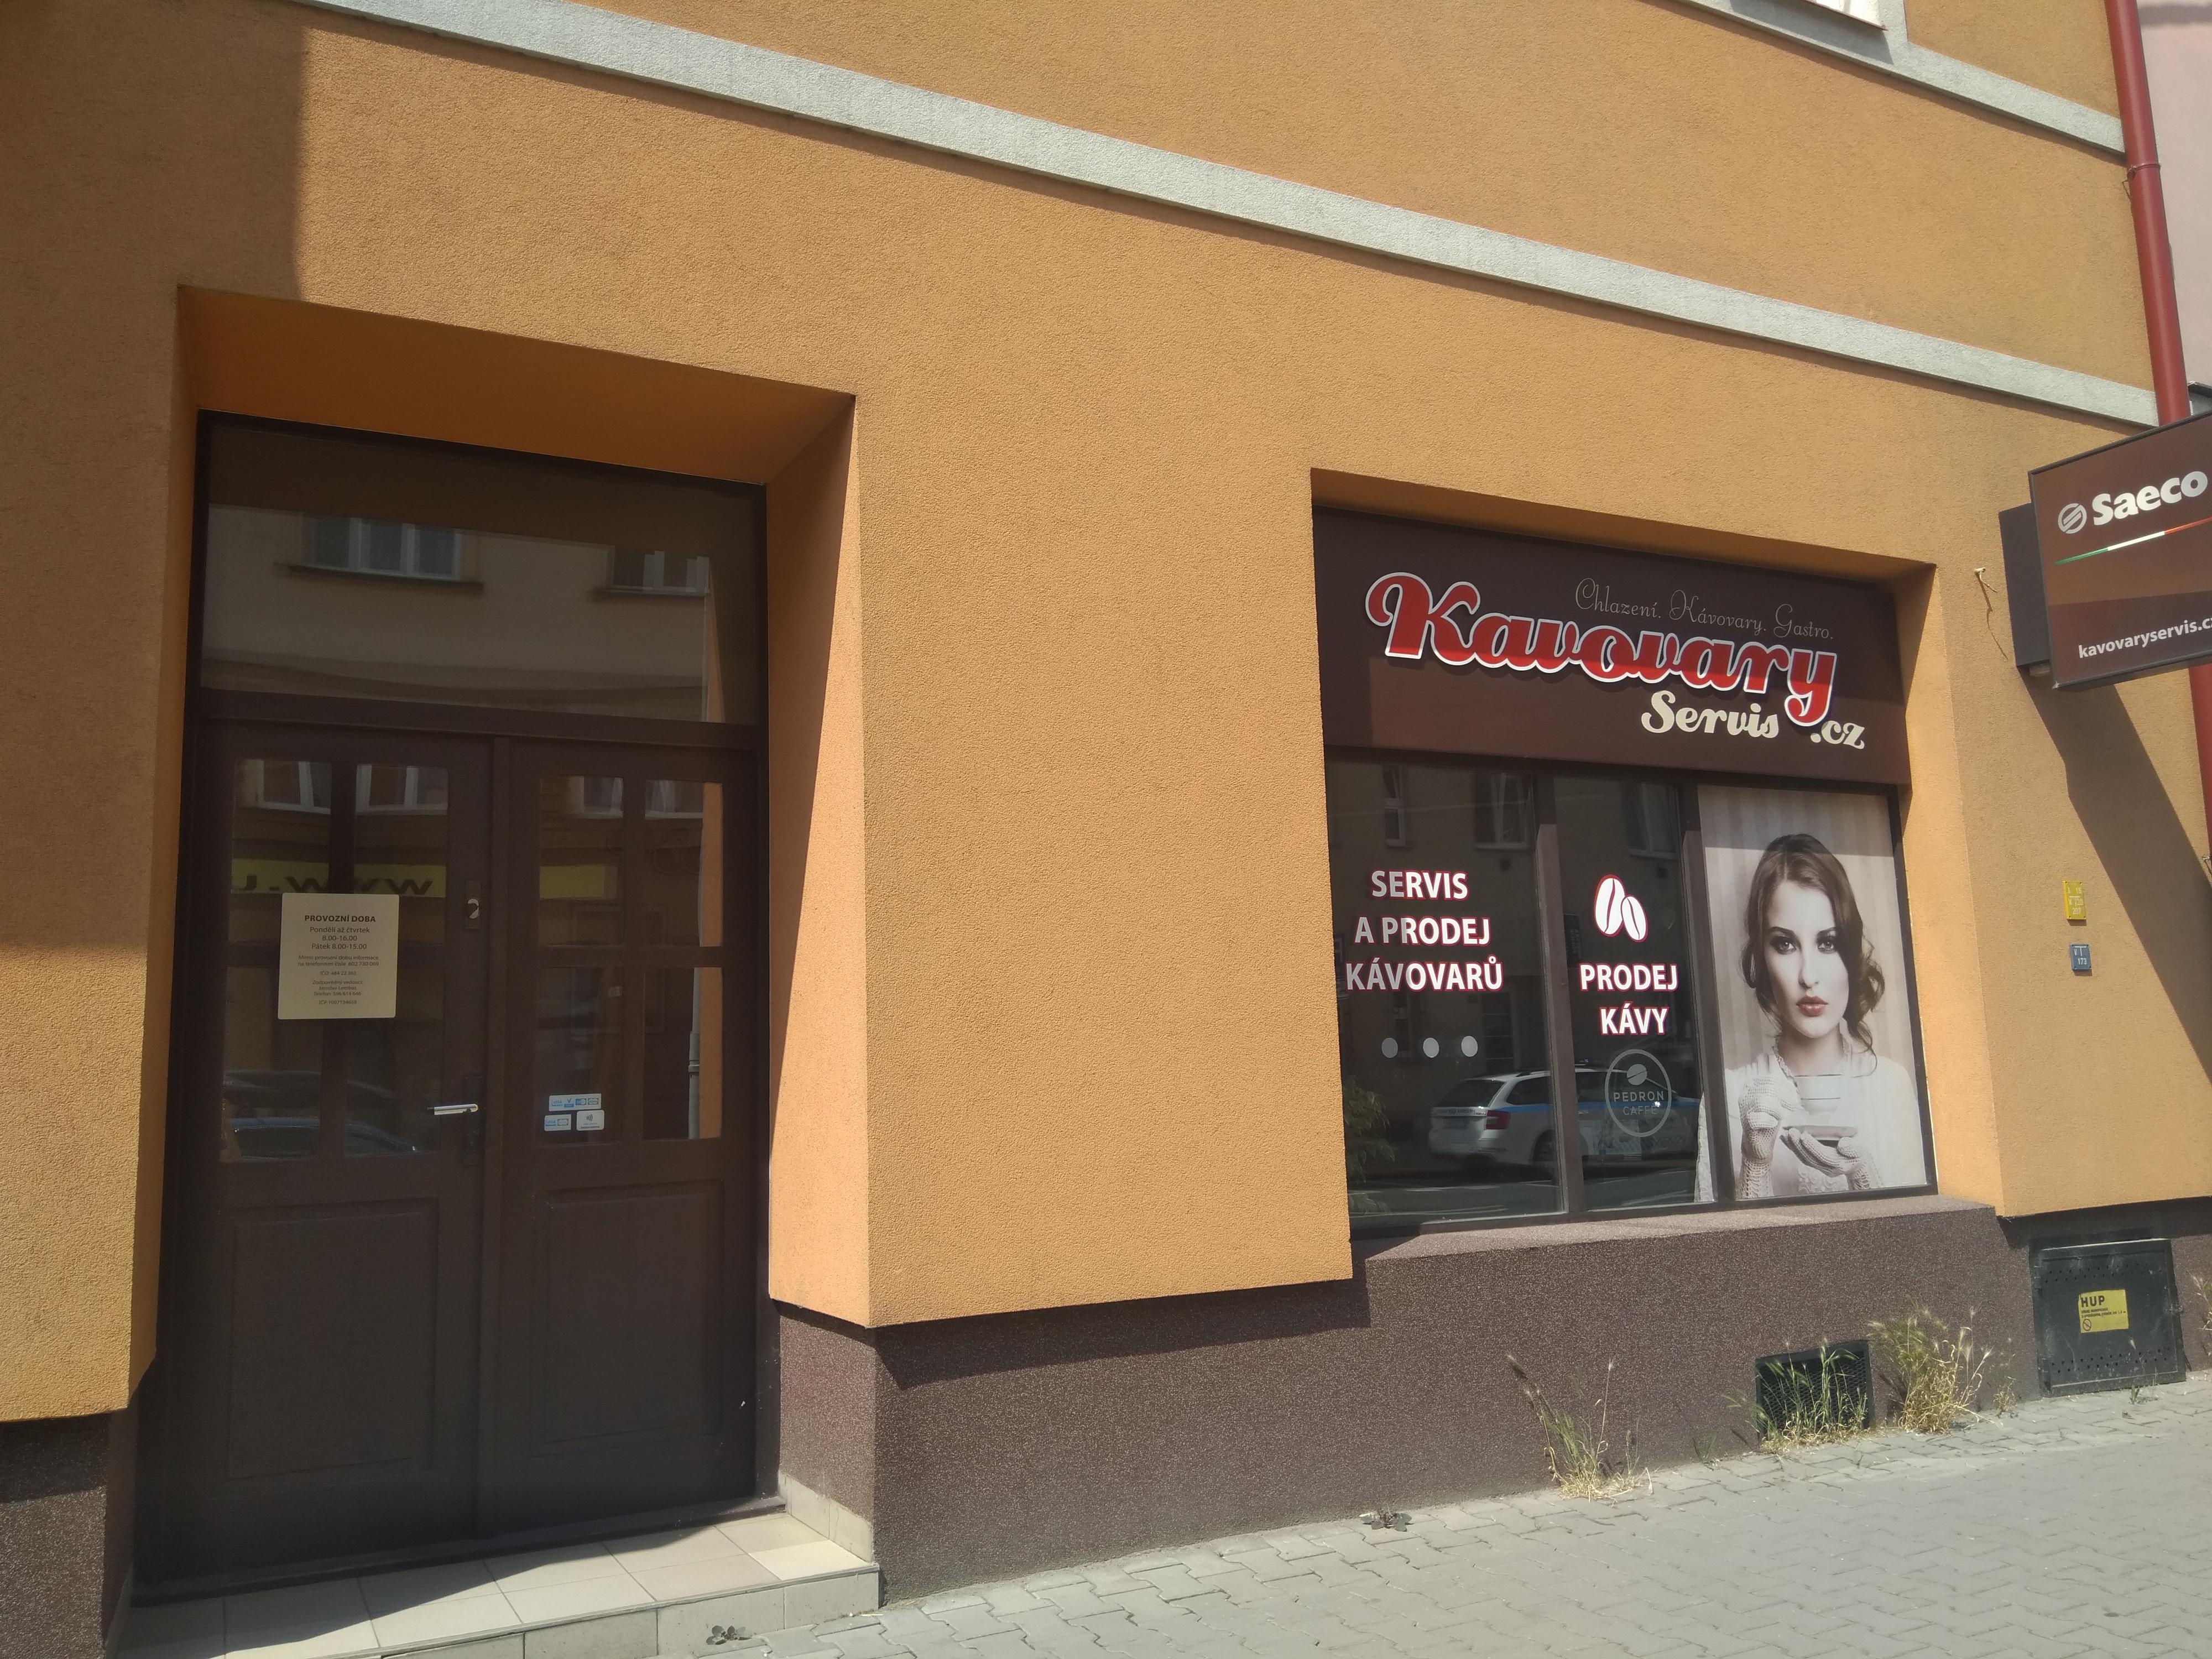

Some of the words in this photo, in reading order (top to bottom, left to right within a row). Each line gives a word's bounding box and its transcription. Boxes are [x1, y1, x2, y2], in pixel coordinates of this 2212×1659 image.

[2092, 471, 2208, 525] Saeco
[1773, 603, 1834, 640] Gastro.
[2078, 617, 2212, 659] kavovaryservis.c
[1365, 572, 1838, 726] Kavovary
[1641, 690, 1779, 739] Servis
[1370, 870, 1469, 900] SERVIS
[1354, 916, 1375, 943] A
[1381, 917, 1491, 945] PRODEJ
[1345, 955, 1503, 990] KÁVOVARŮ
[1579, 964, 1678, 991] PRODEJ
[1599, 1003, 1668, 1035] KÁVY
[1613, 1091, 1664, 1102] PEDRON
[2081, 1295, 2105, 1307] HUP
